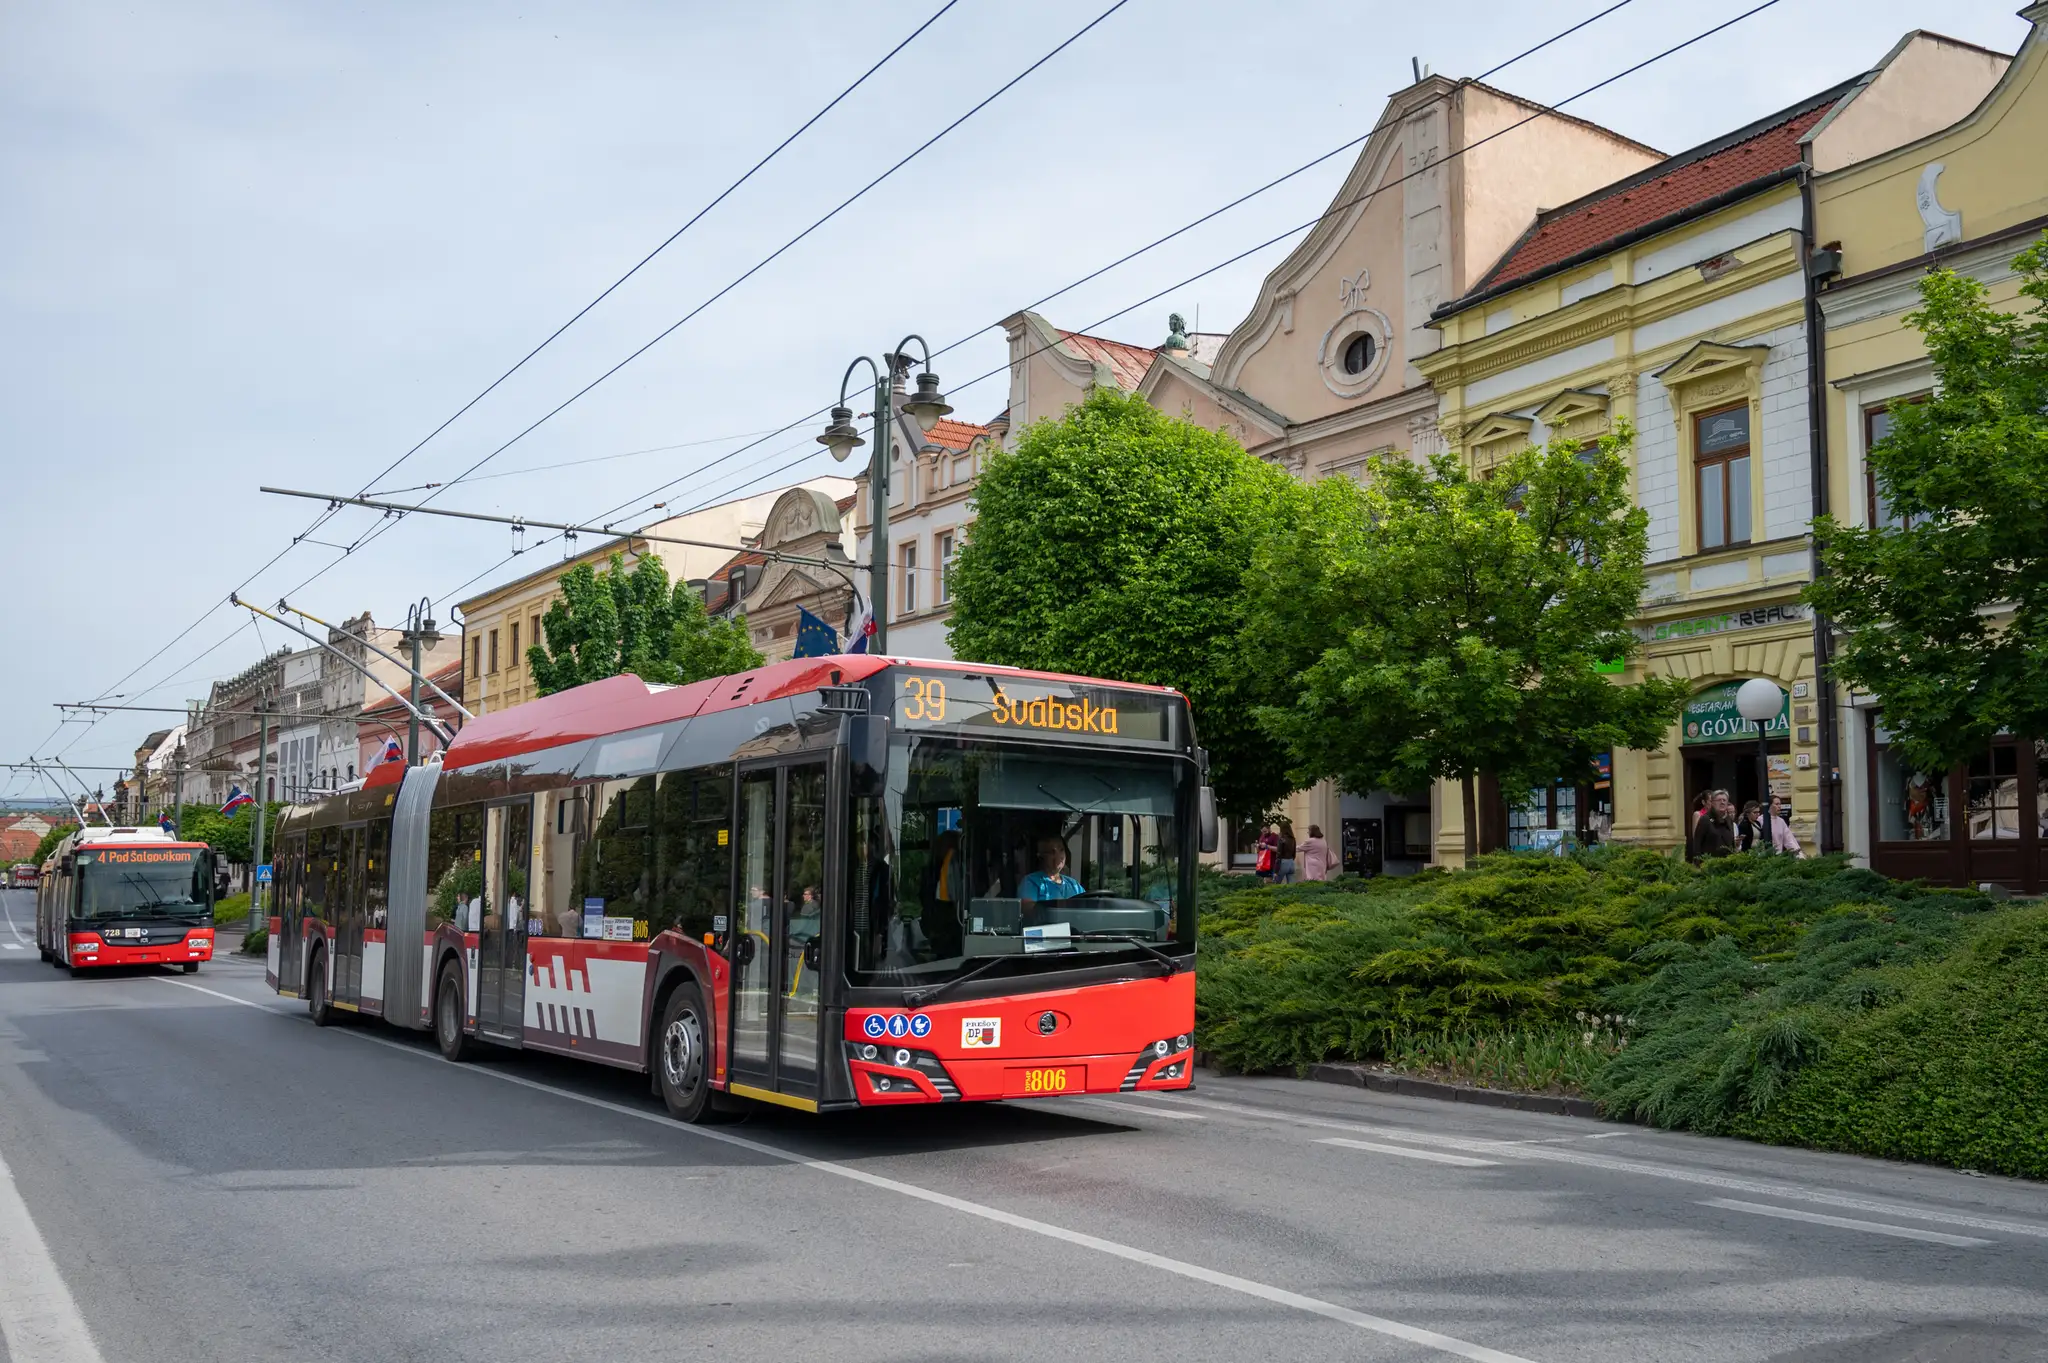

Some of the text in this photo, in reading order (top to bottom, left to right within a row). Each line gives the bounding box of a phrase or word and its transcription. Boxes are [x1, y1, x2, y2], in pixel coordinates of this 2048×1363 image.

[1655, 606, 1795, 640] GARANT REAL
[904, 676, 1118, 734] 39 Švábska
[97, 850, 191, 863] 4 Pod Šalgovikom
[104, 929, 121, 937] 728
[965, 1020, 998, 1028] PREŠOV
[968, 1028, 981, 1038] DP
[1031, 1068, 1066, 1092] 806
